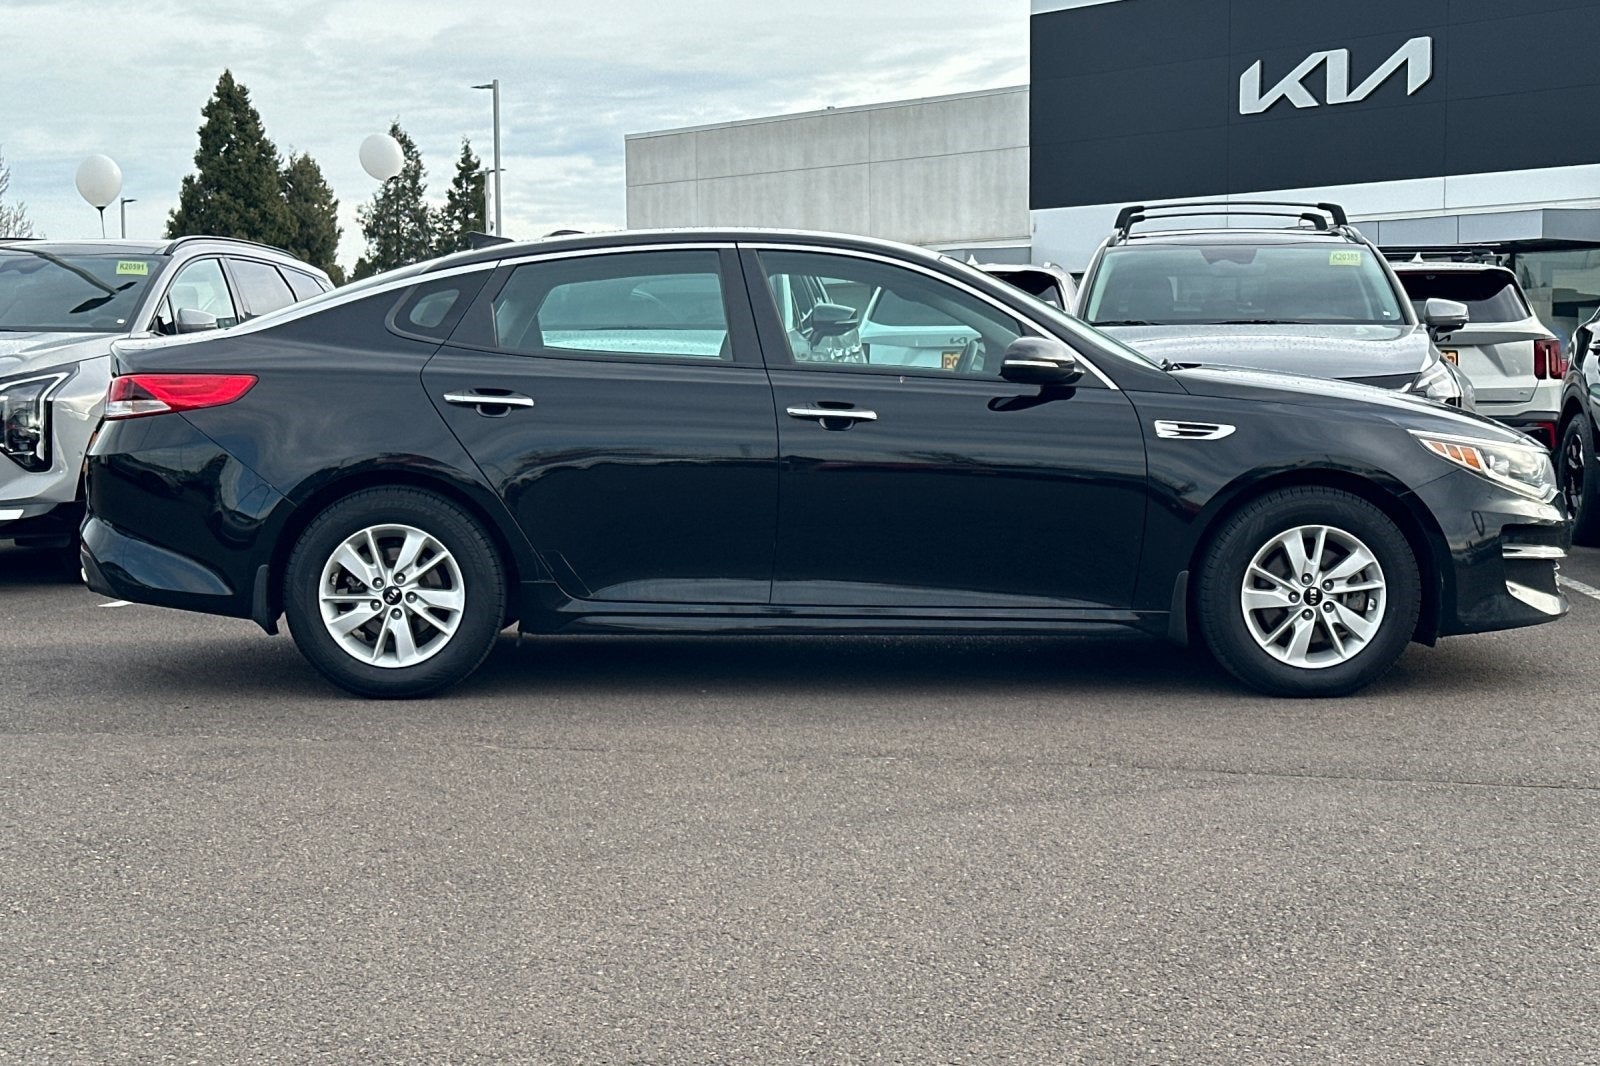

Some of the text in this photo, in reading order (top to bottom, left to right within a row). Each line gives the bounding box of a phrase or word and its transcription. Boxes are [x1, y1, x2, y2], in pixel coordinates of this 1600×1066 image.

[1239, 36, 1433, 114] KIA
[385, 588, 400, 603] KIA
[1309, 588, 1318, 605] KIA
